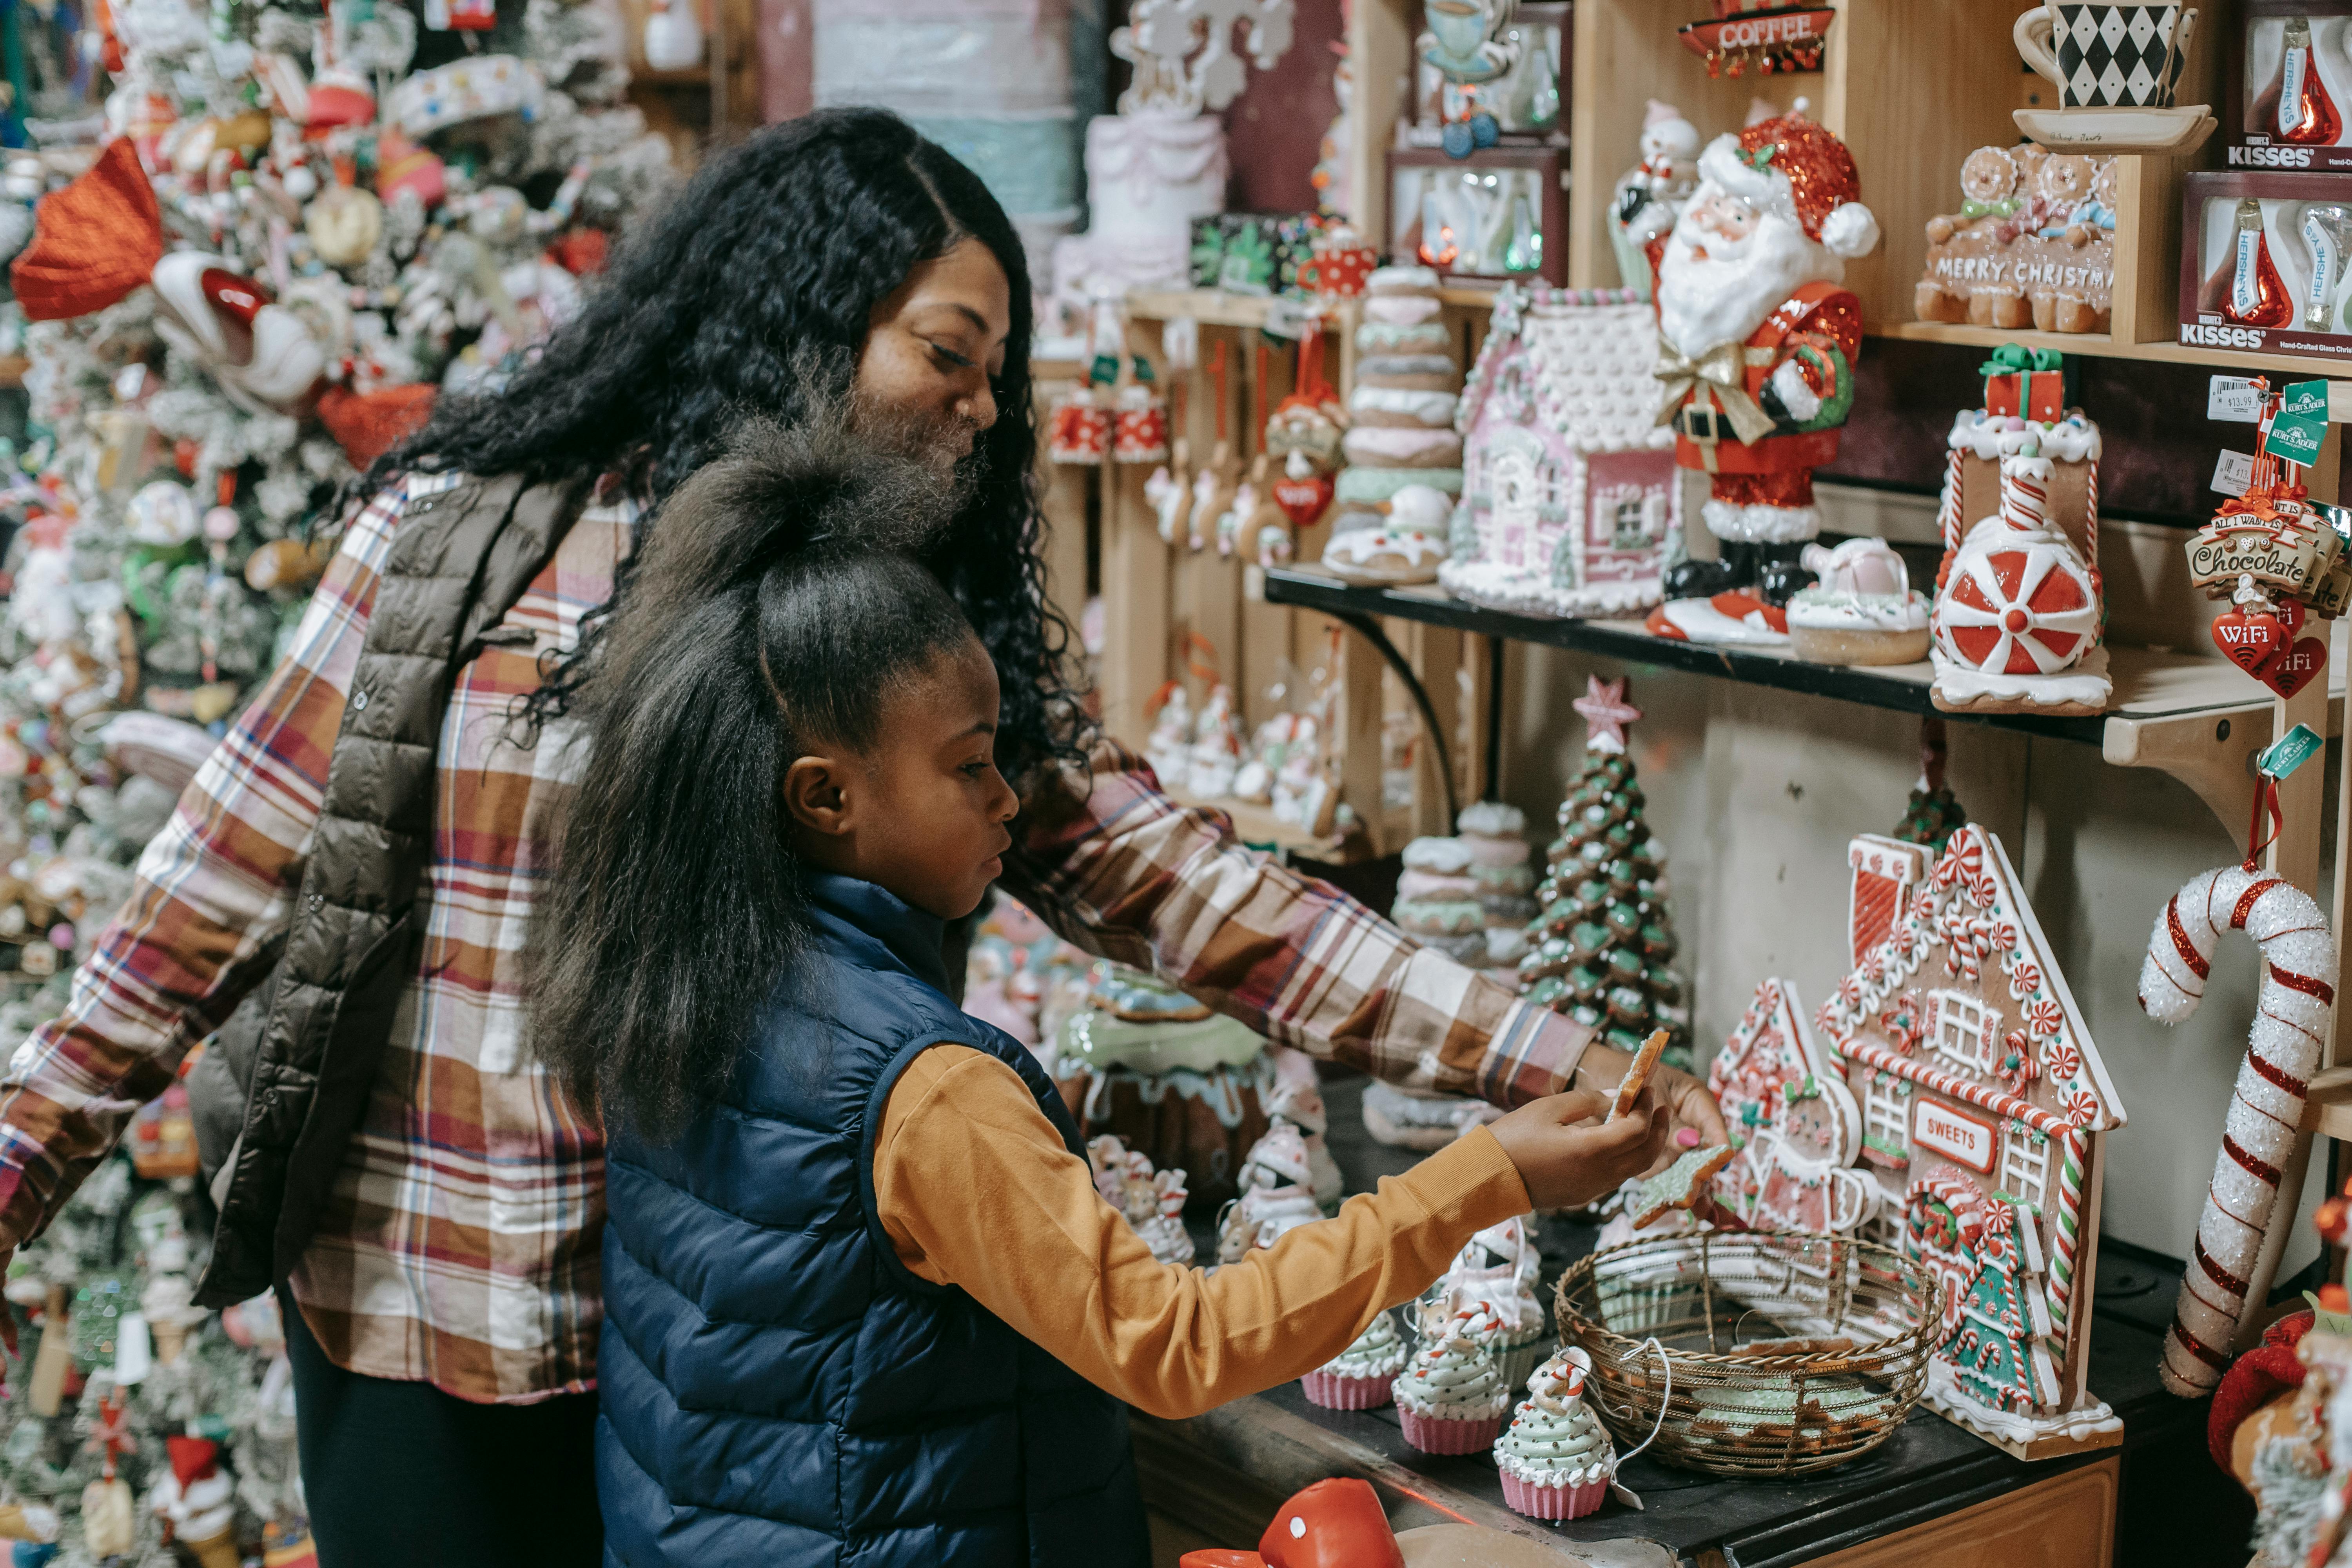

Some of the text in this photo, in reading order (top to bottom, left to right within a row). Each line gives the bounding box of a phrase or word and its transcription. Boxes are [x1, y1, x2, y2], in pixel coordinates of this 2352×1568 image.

[1719, 15, 1812, 49] COFFEE
[2283, 53, 2295, 124] HERSHEY'S
[1935, 257, 2005, 281] MERRY
[2305, 225, 2326, 297] HERSHEY'S
[2280, 341, 2318, 351] Hand-Crafted
[2319, 344, 2336, 352] Glass
[2228, 396, 2252, 407] $13.99
[2288, 404, 2303, 413] KURT
[2308, 401, 2326, 410] ADLER
[2272, 430, 2291, 441] KURT
[2295, 439, 2318, 450] ADLER
[2274, 503, 2287, 512] NT
[2288, 504, 2298, 514] IS
[2215, 518, 2231, 529] ALL
[2234, 517, 2238, 526] I
[2269, 520, 2281, 528] IS
[2192, 546, 2305, 581] Chocolate
[2219, 626, 2269, 644] WiFi
[1927, 1118, 1975, 1150] SWEETS
